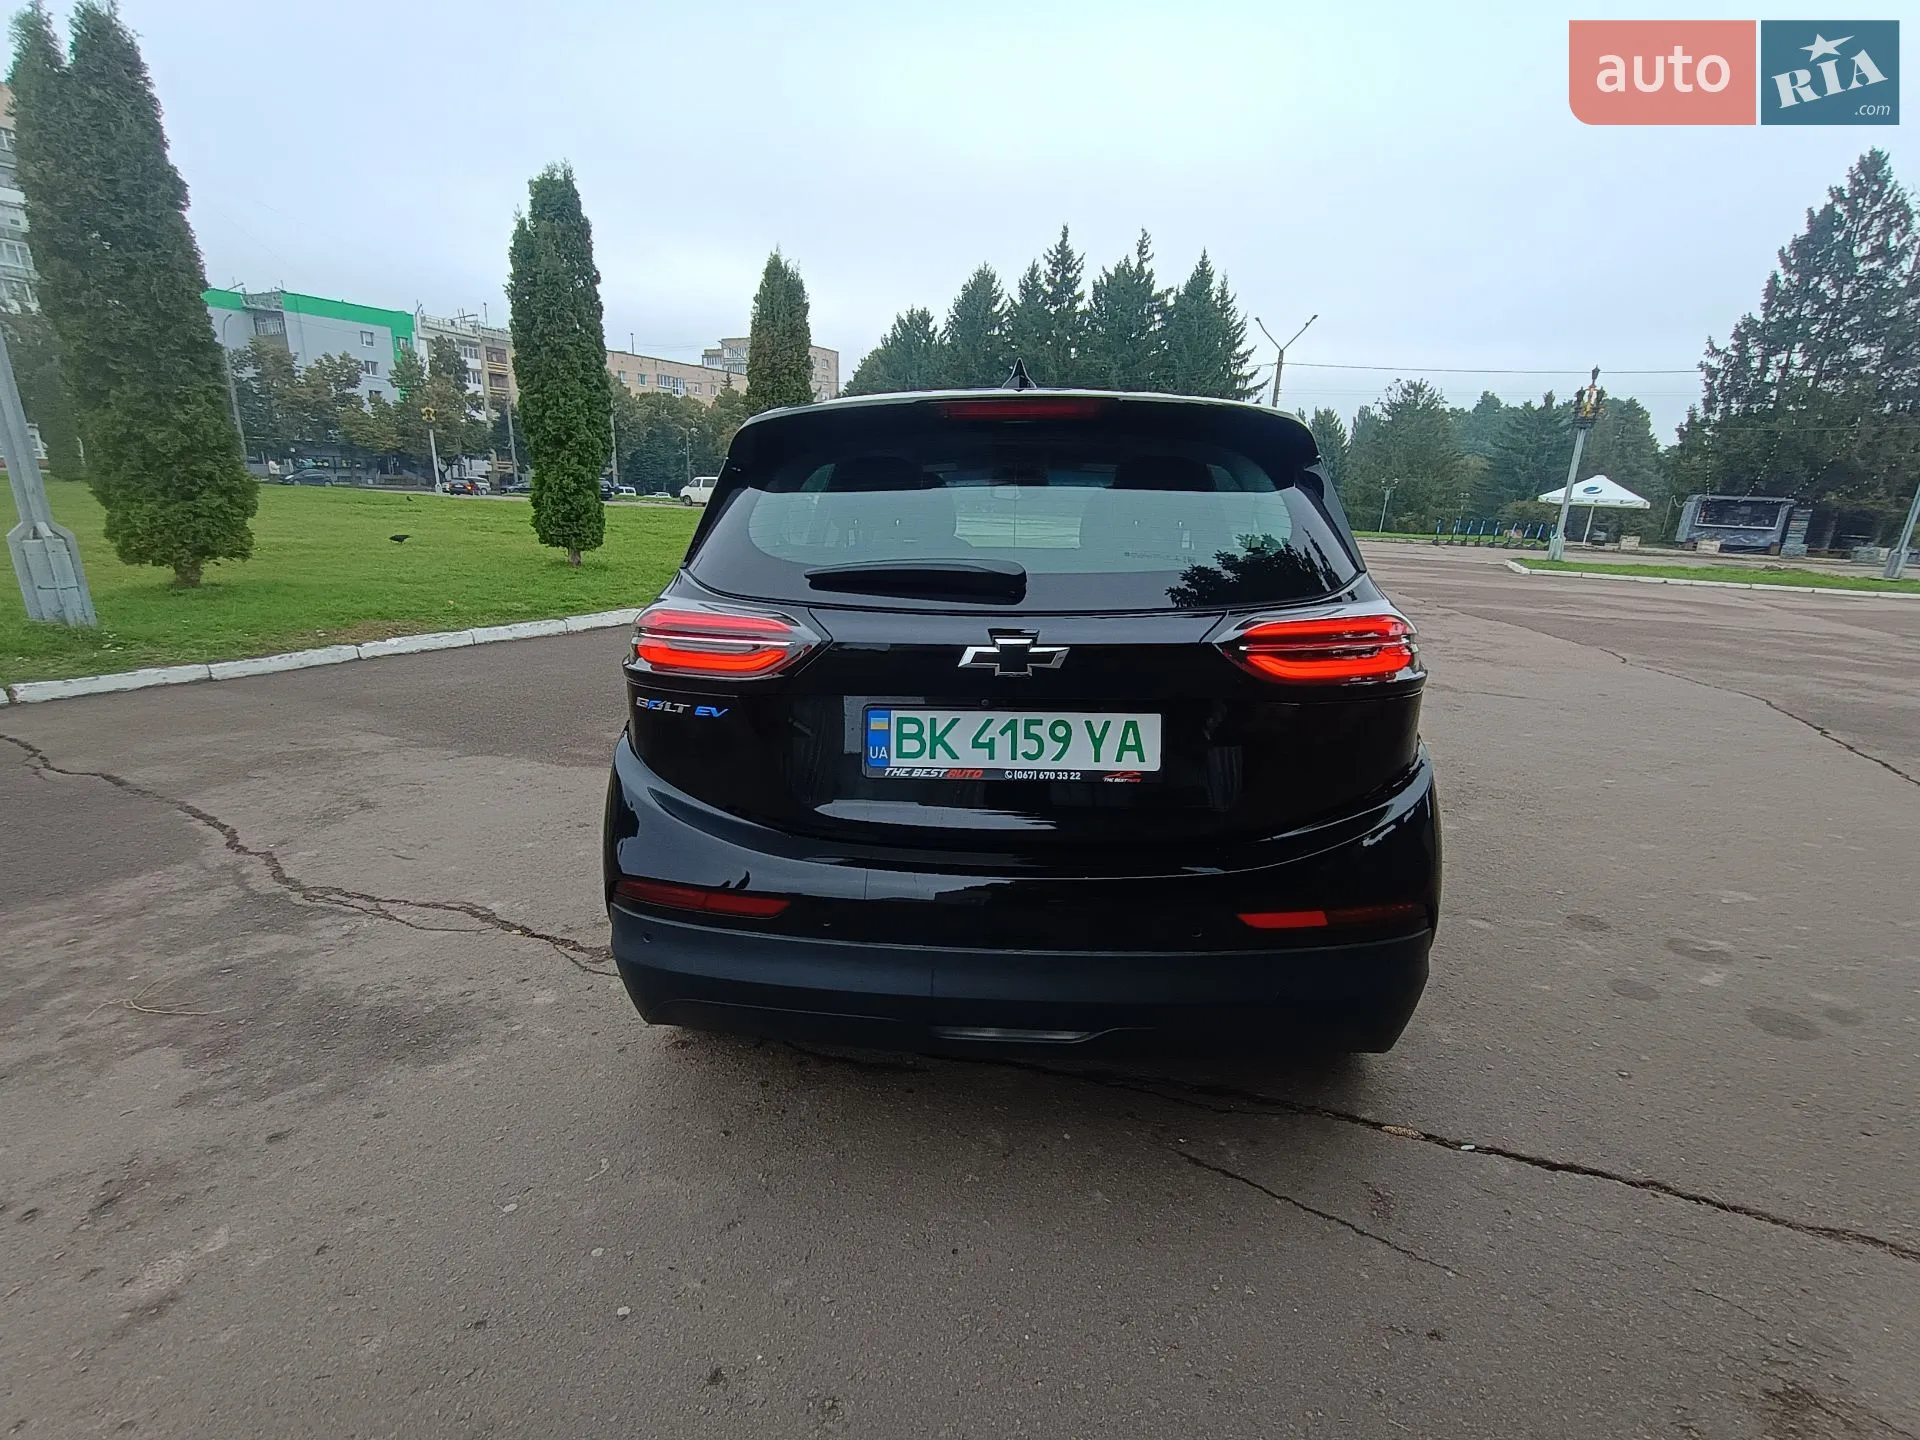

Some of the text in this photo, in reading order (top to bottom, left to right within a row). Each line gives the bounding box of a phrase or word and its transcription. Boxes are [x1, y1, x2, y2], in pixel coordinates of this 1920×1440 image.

[636, 696, 728, 717] BOLT EV
[895, 716, 1146, 763] BK 4159 YA
[869, 746, 888, 760] UA
[884, 767, 912, 777] THE
[1014, 770, 1081, 780] (067) 670 33 22
